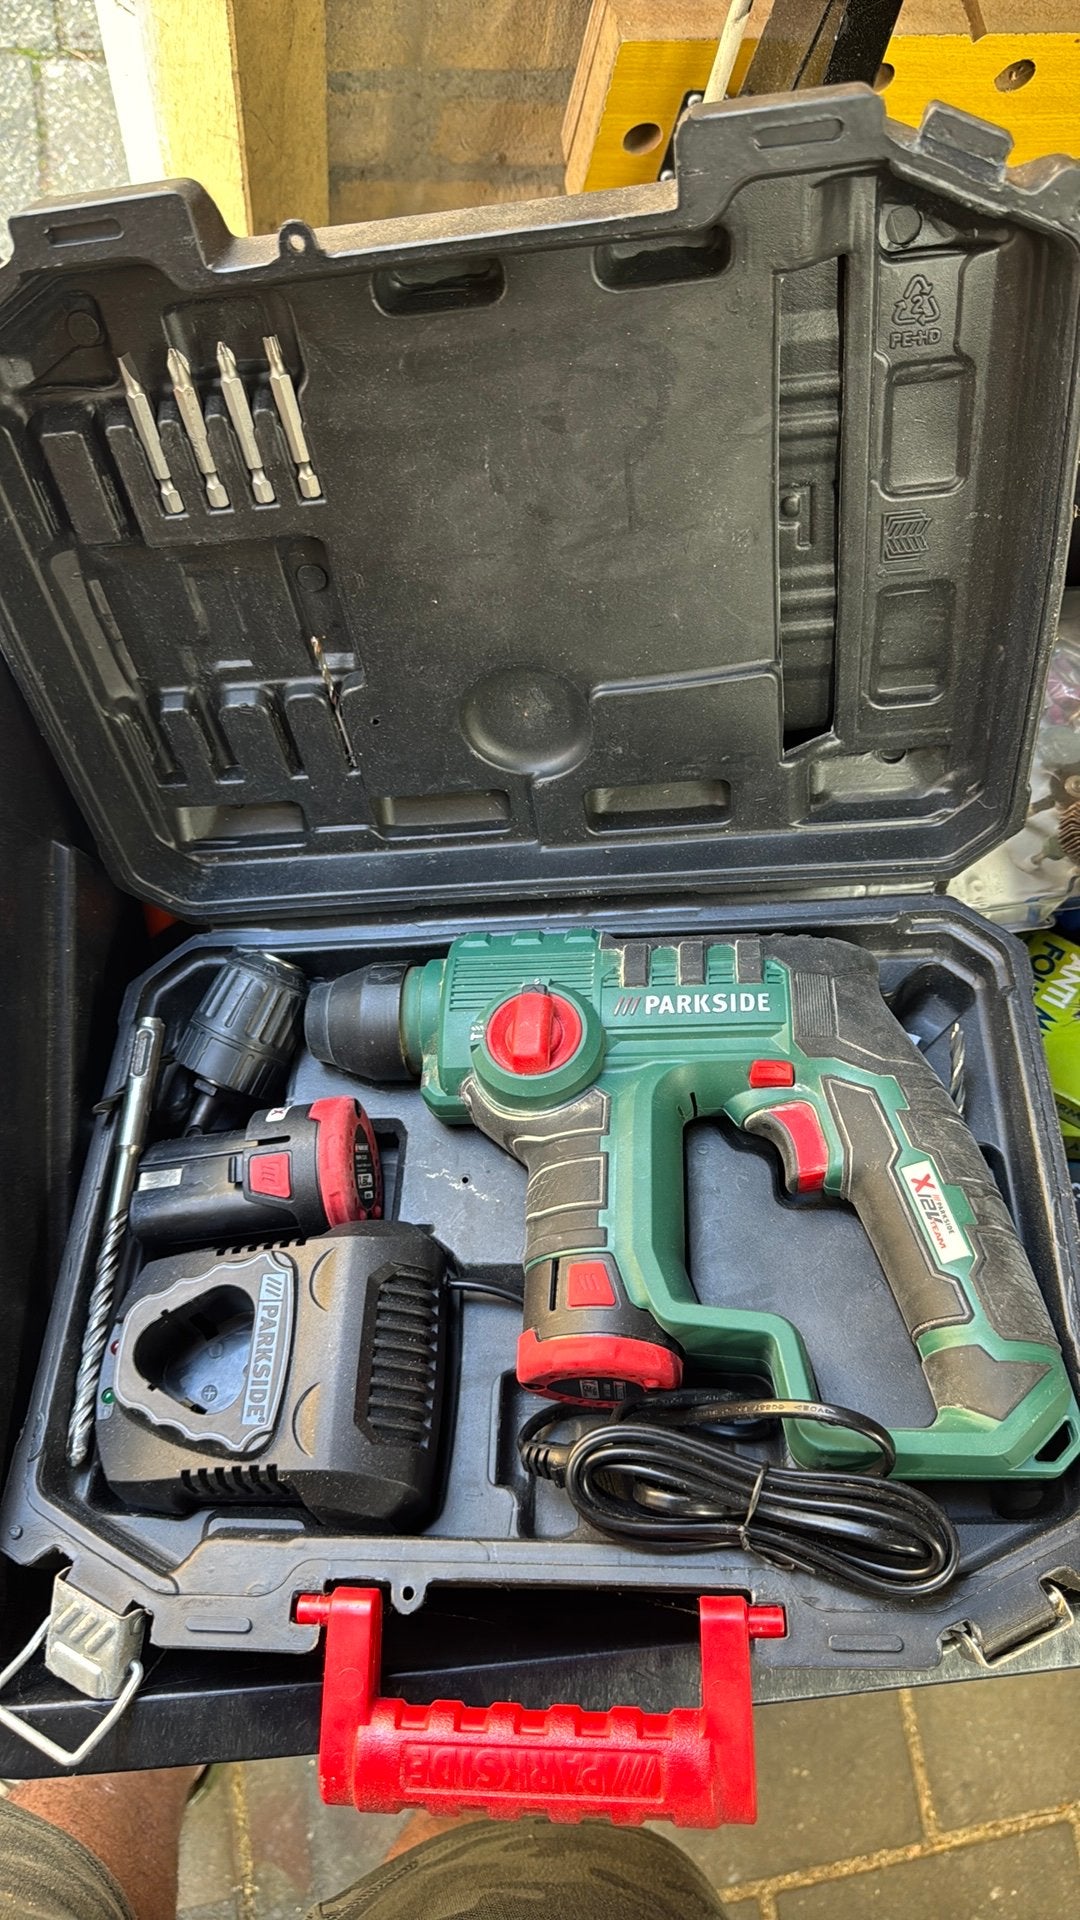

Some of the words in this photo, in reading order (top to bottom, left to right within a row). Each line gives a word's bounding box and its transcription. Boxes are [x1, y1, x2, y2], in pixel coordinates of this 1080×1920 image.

[889, 328, 942, 349] PE-HD
[1041, 953, 1080, 1009] ANTI
[644, 992, 771, 1015] PARKSIDE
[930, 1217, 947, 1249] TEAM
[937, 1201, 956, 1234] PARKSIDE
[408, 1747, 607, 1795] PARKSIDE
